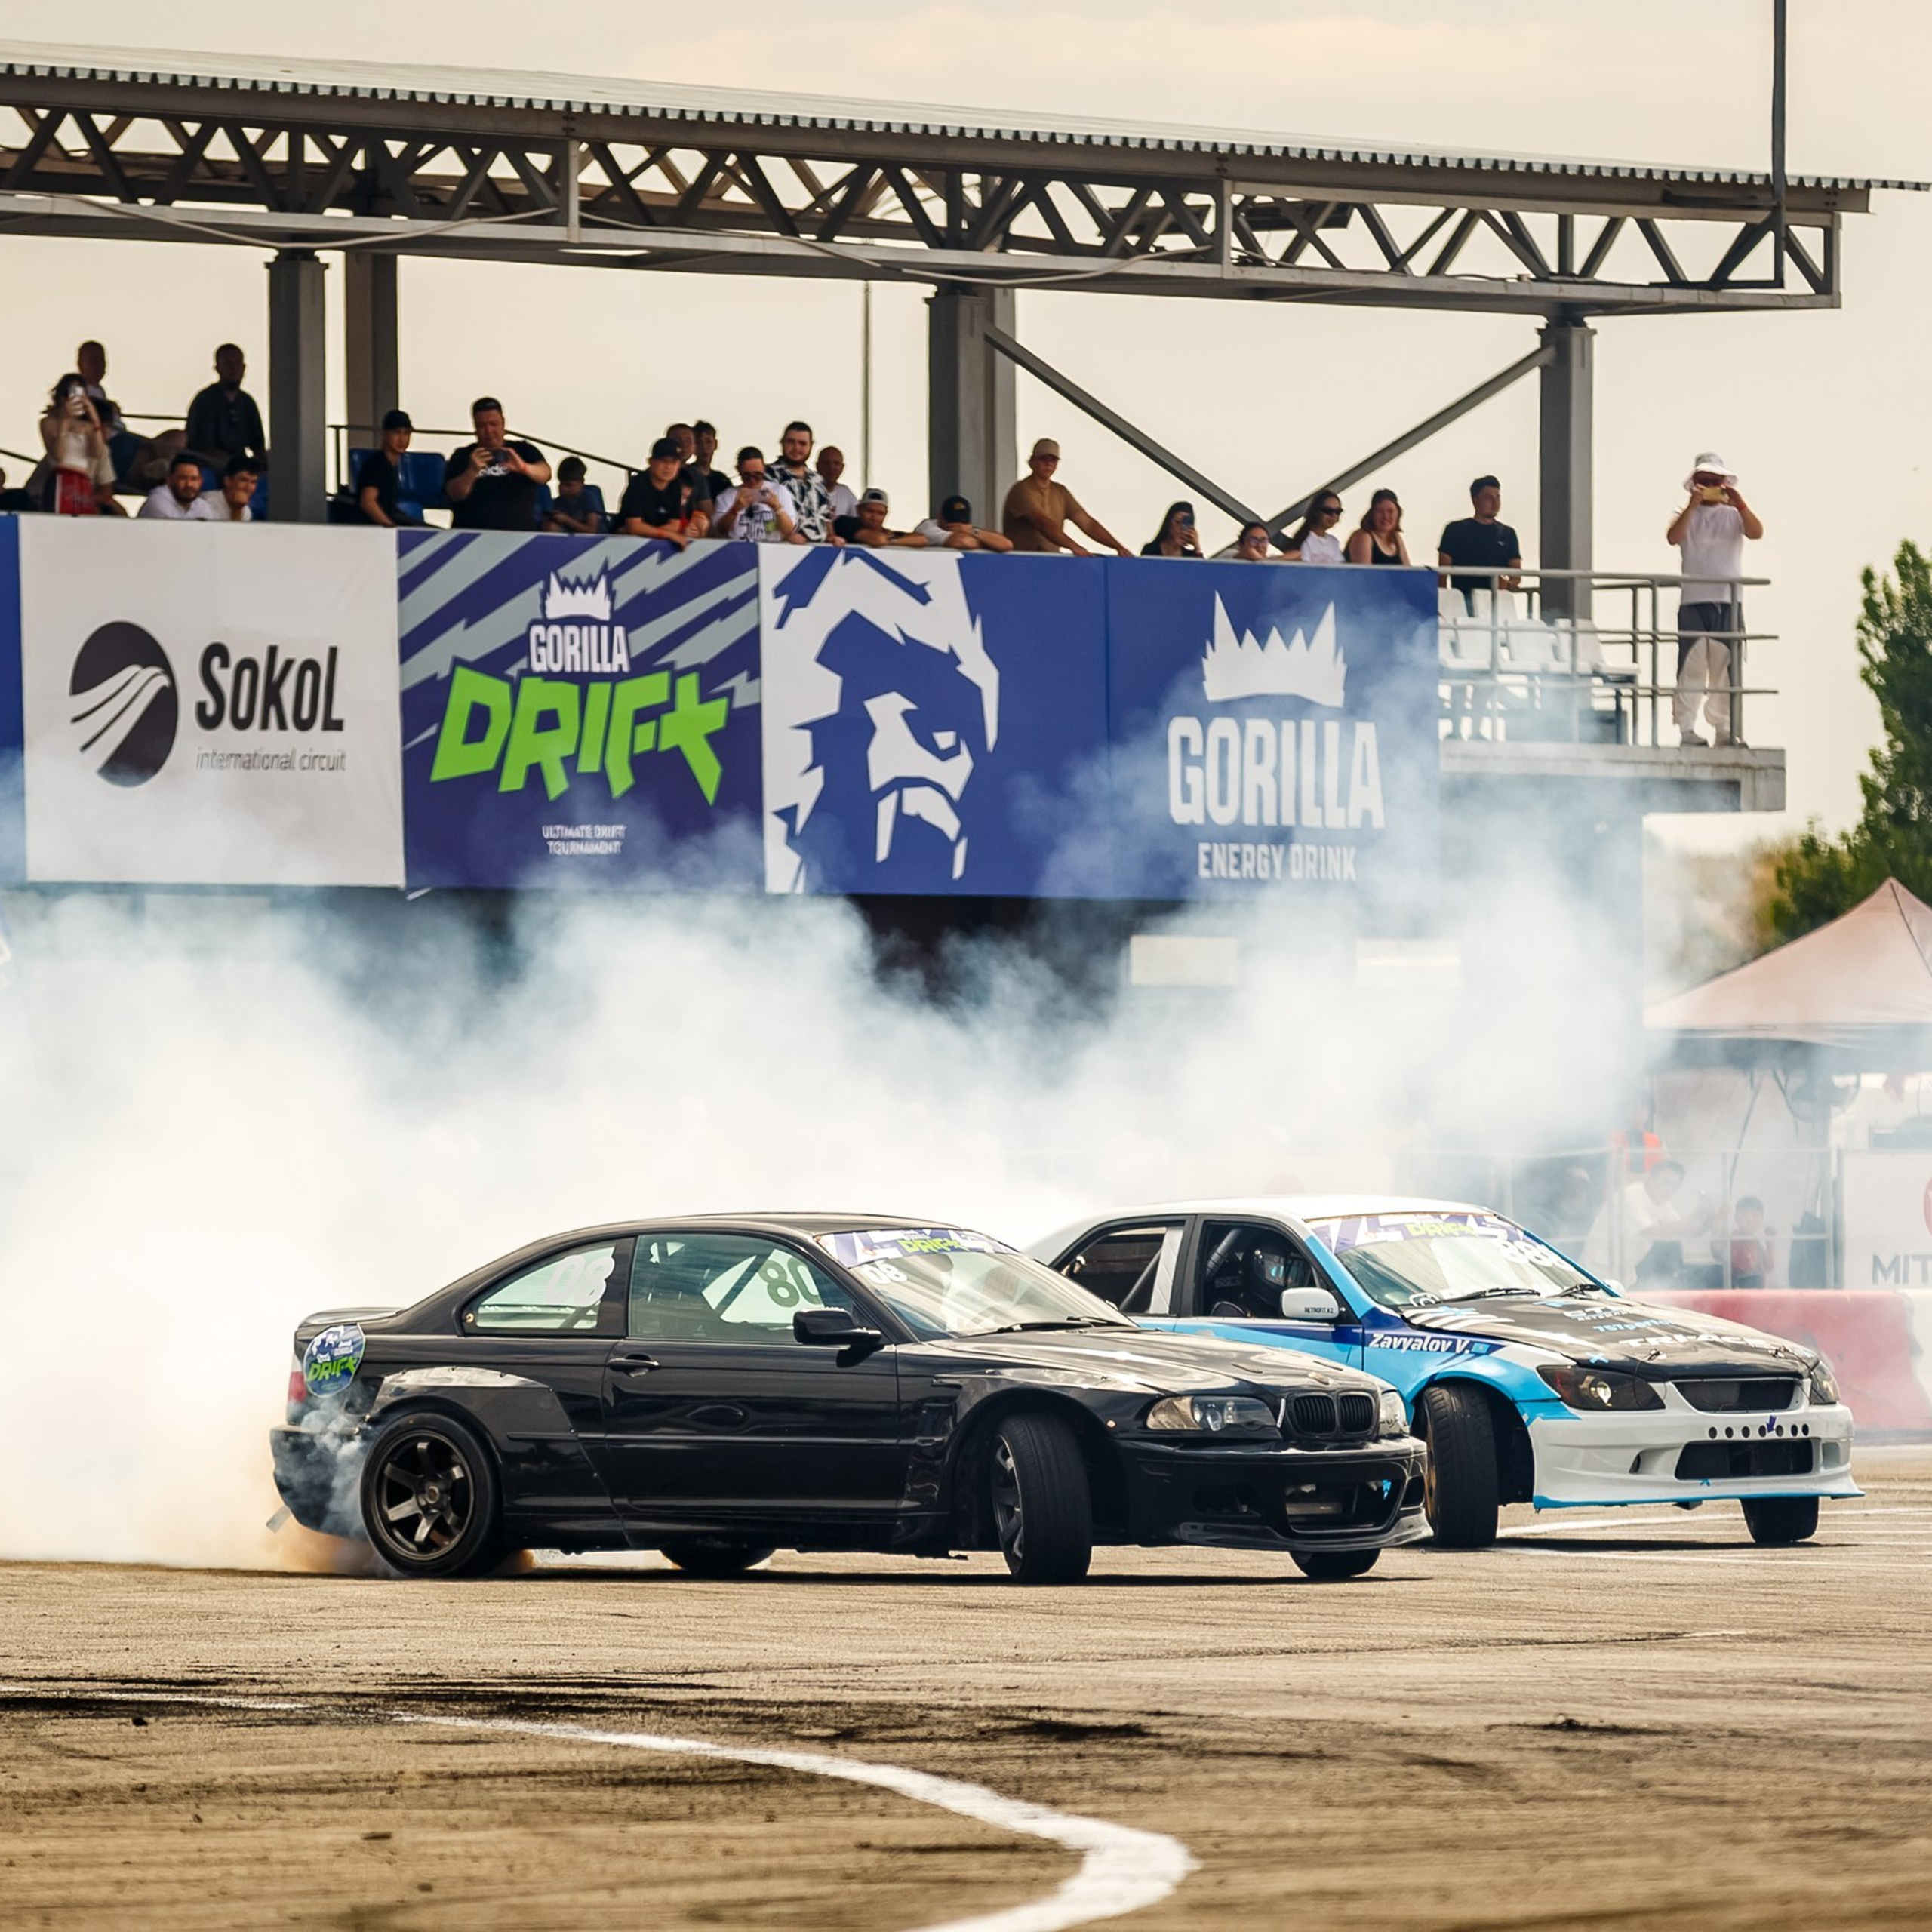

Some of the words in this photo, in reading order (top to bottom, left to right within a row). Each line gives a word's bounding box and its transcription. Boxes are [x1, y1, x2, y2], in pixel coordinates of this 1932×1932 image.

[529, 625, 630, 673] GORILLA
[429, 665, 730, 807] DRIFT
[196, 746, 295, 771] international
[299, 747, 347, 771] circuit
[1168, 716, 1386, 829] GORILLA
[542, 824, 592, 839] ULTIMATE
[594, 824, 626, 839] DRIFT
[547, 841, 623, 855] TOURNAMENT
[1198, 842, 1283, 881] ENERGY
[1290, 844, 1357, 881] DRINK
[1368, 1333, 1453, 1353] Zavyalov
[1454, 1339, 1470, 1354] V.
